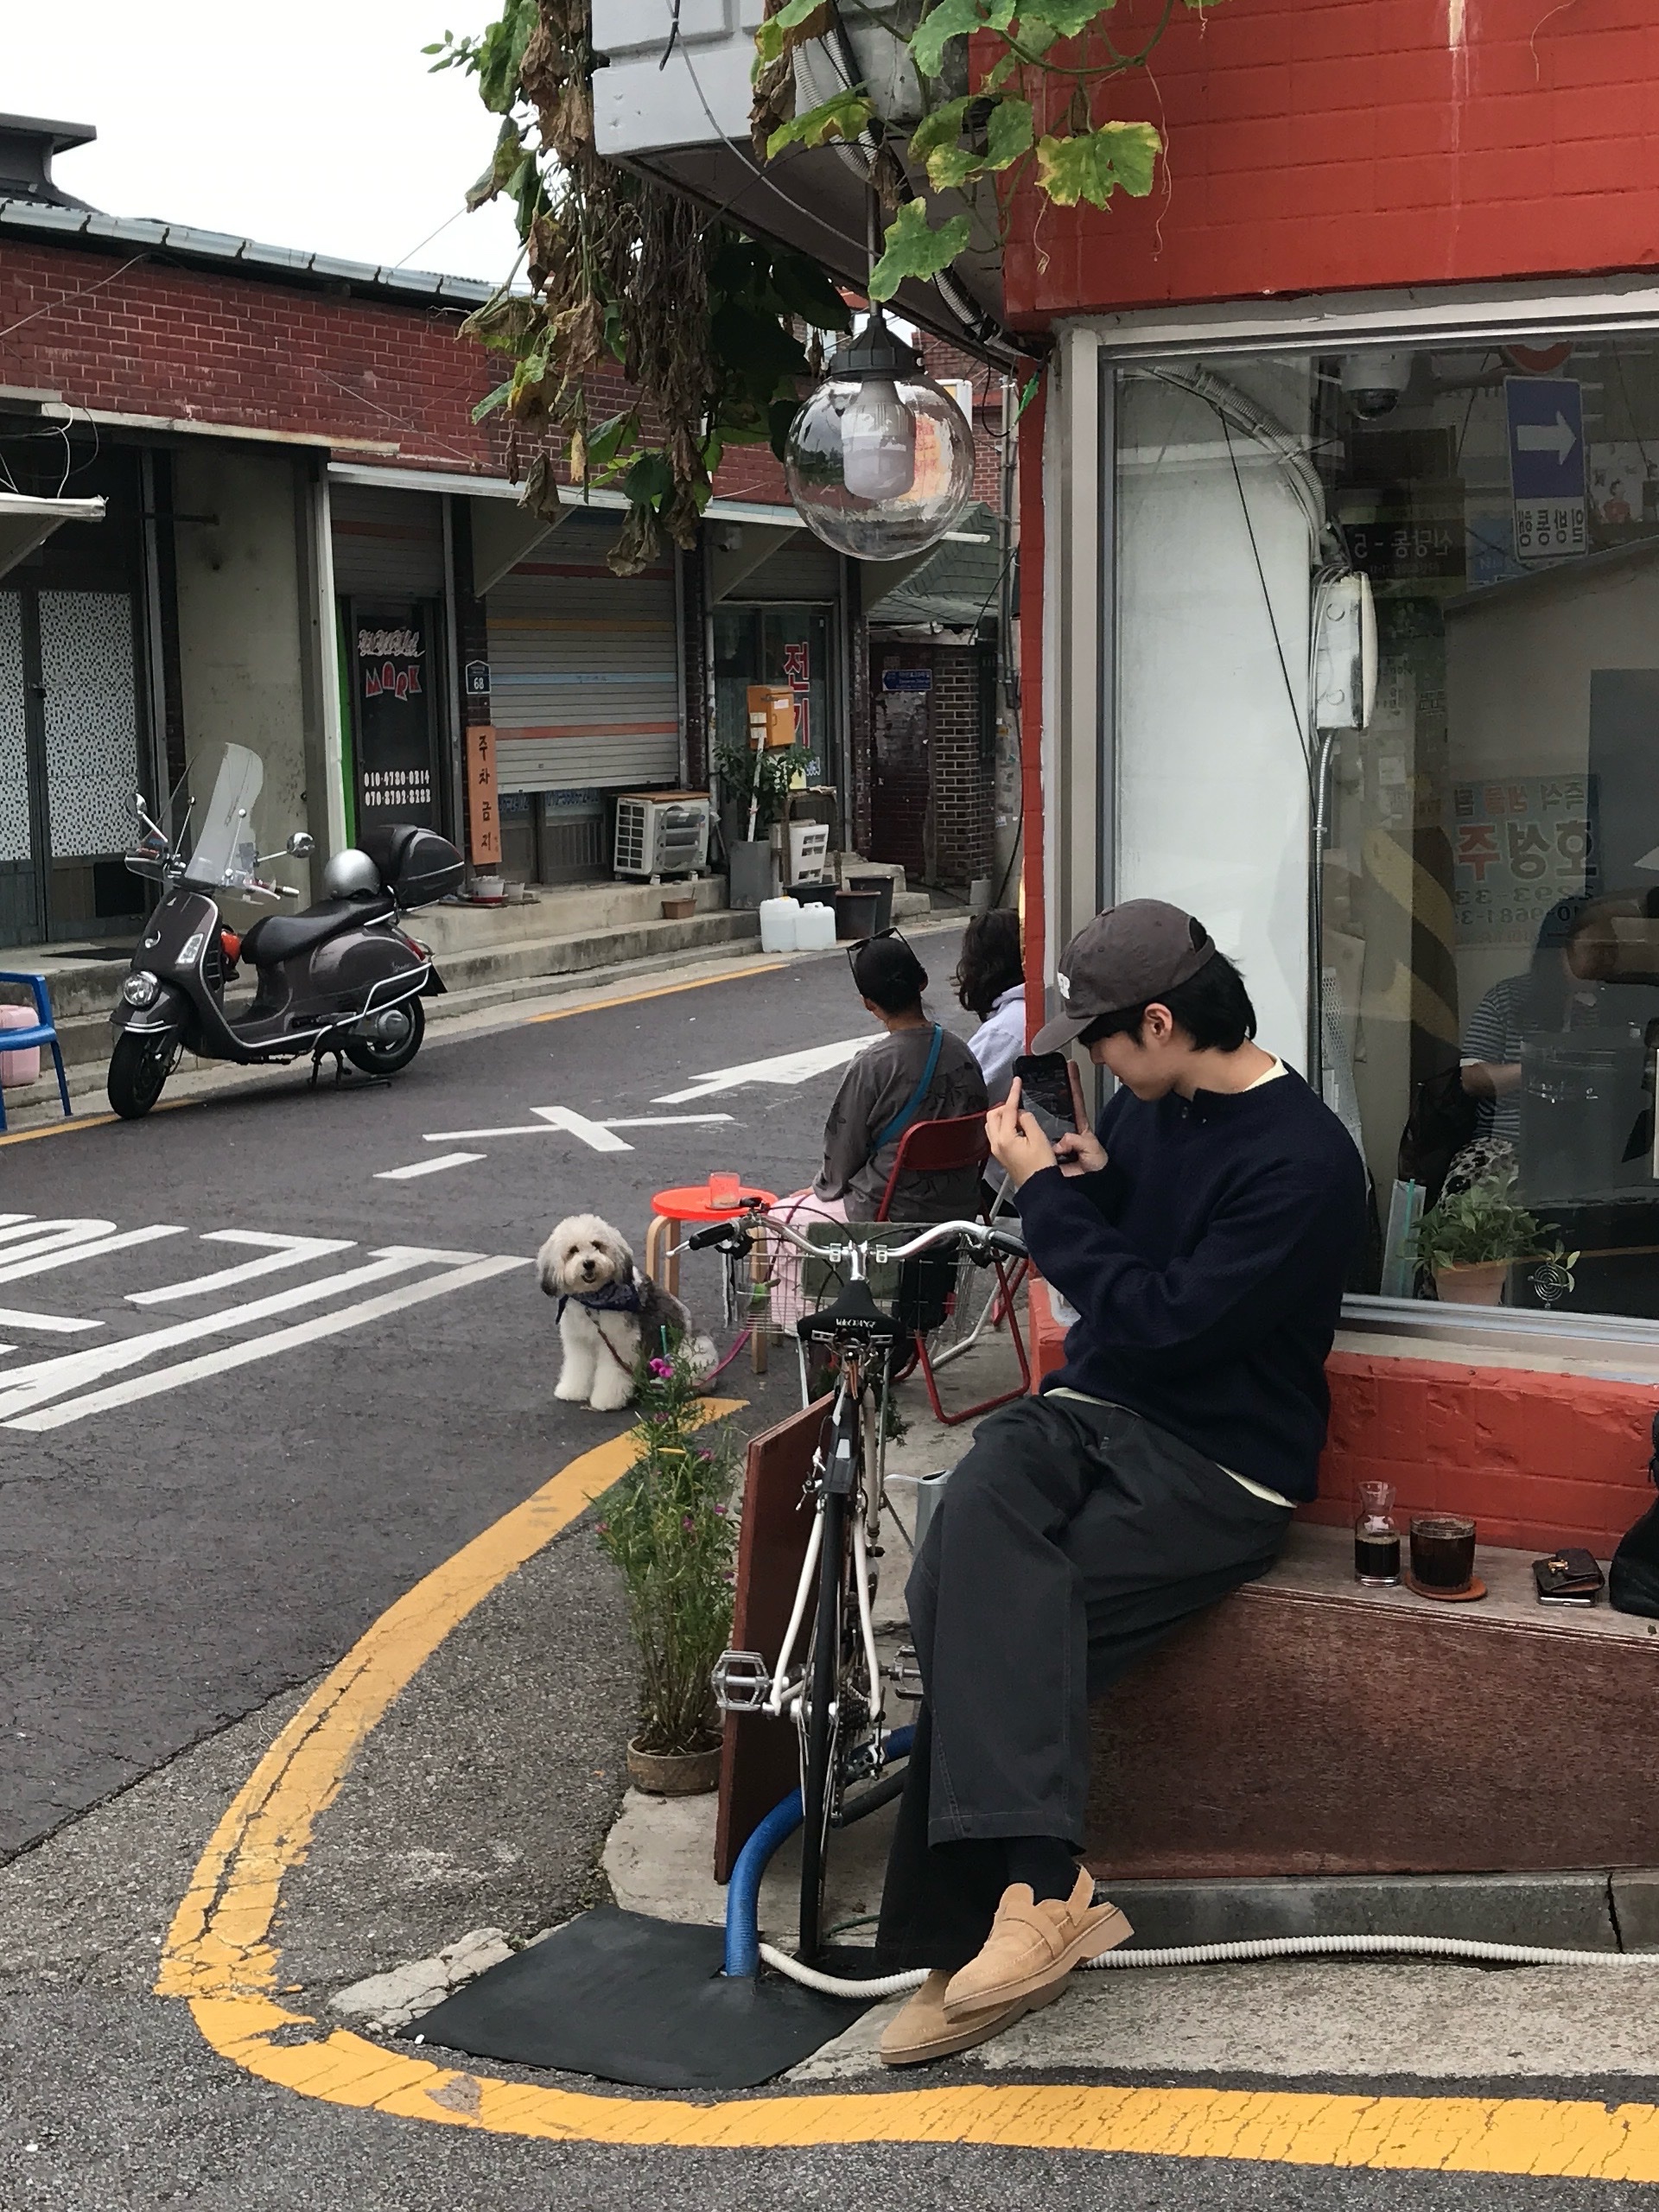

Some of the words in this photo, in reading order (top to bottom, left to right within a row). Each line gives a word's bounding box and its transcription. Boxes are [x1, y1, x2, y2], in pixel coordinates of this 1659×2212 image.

[365, 660, 423, 701] MARK
[474, 677, 485, 690] 68
[783, 641, 810, 749] 전기
[479, 734, 492, 851] 주차금지
